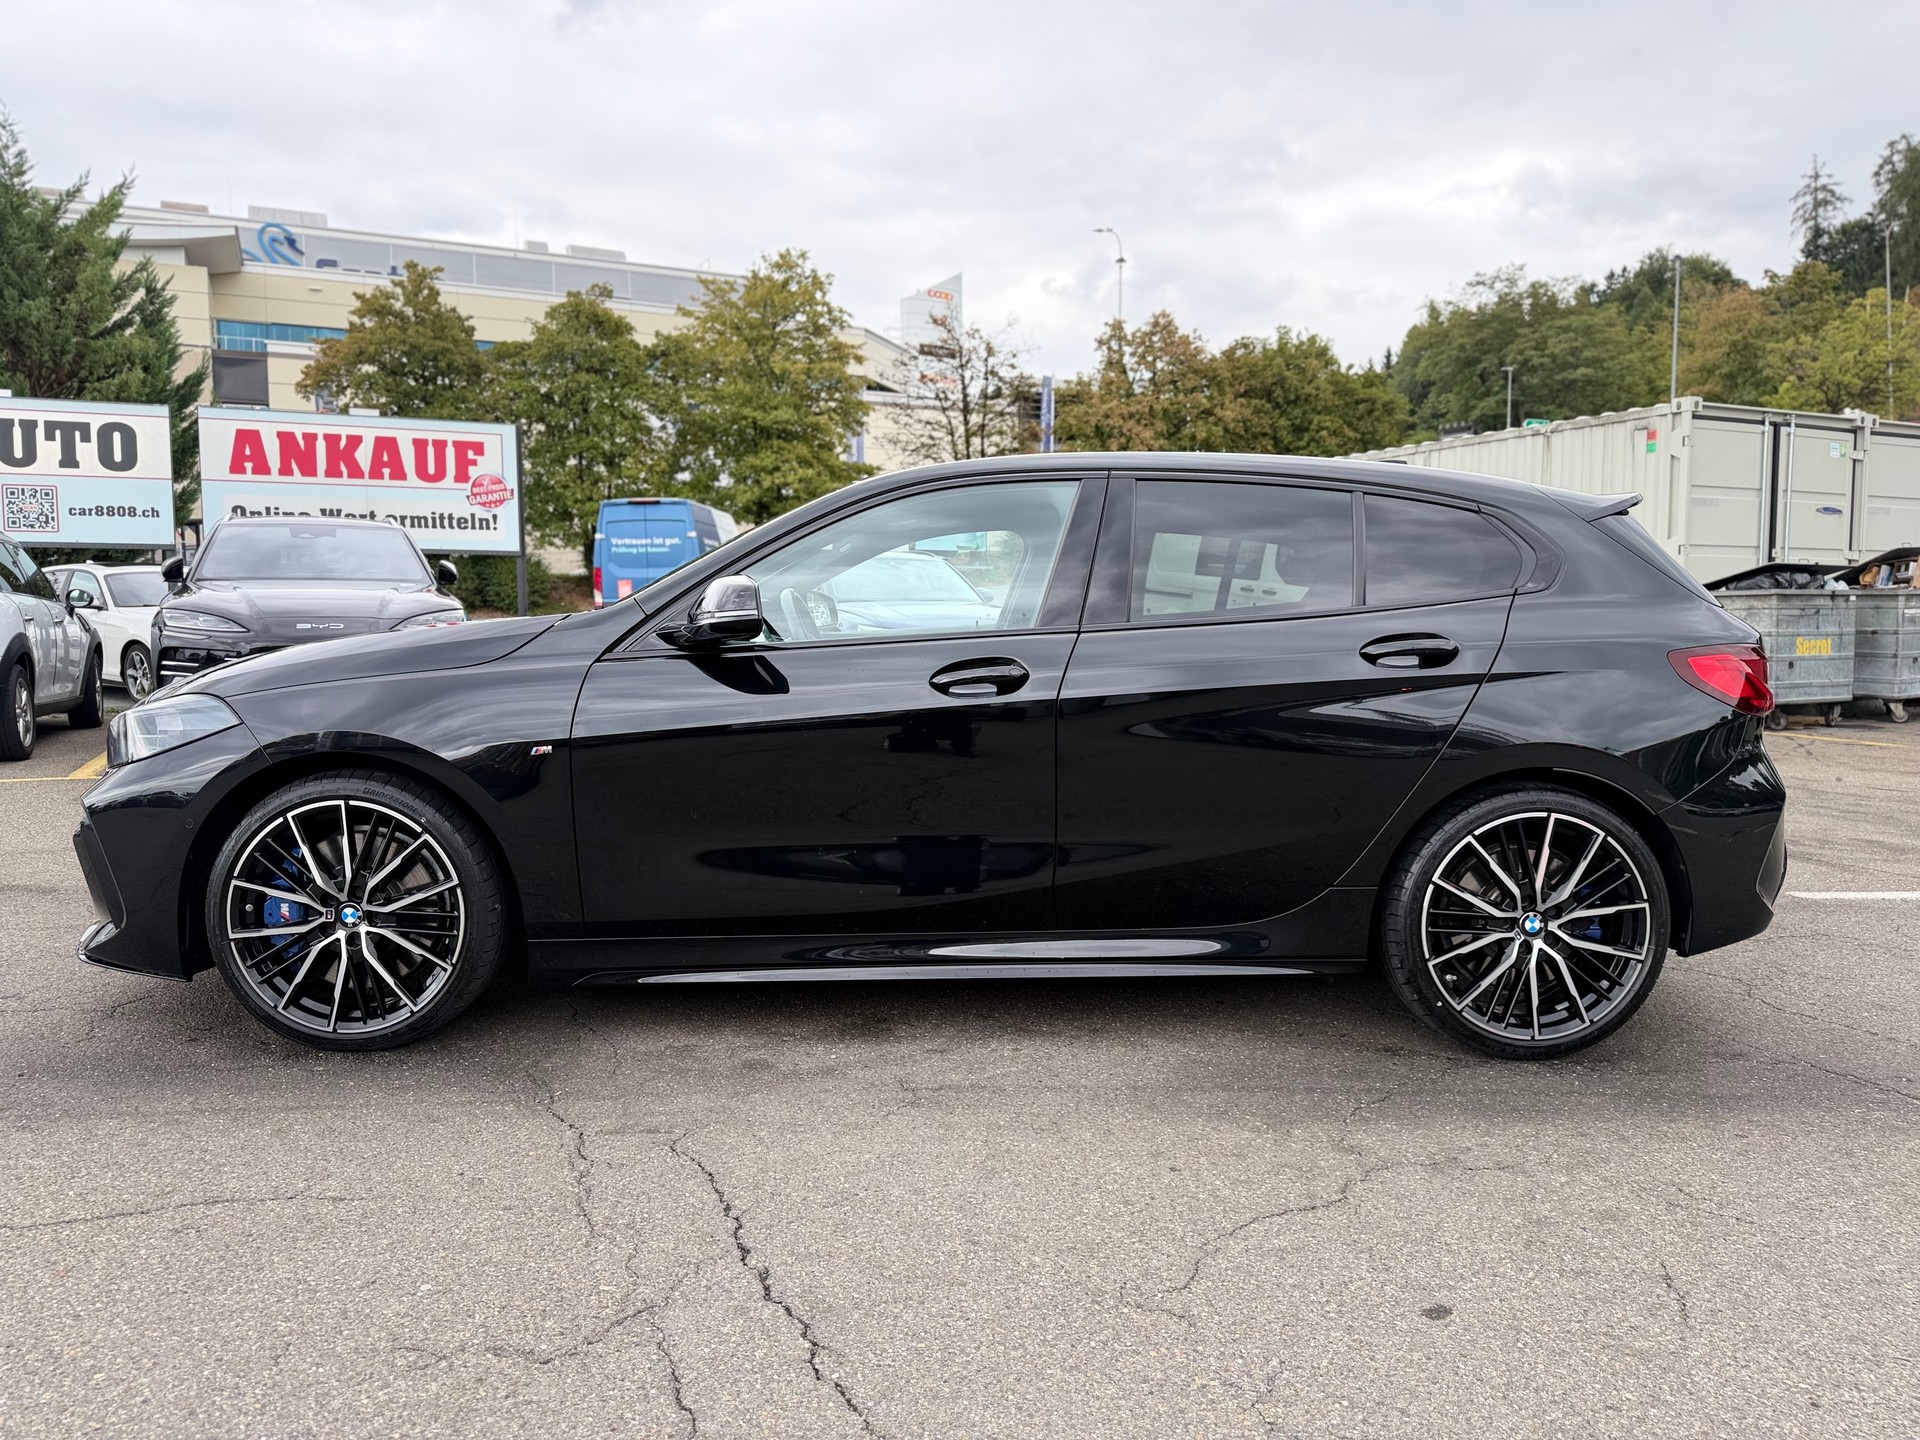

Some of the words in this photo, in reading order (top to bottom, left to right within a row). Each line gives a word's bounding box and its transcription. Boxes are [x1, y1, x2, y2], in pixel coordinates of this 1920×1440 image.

[0, 418, 138, 472] UTO
[229, 428, 485, 484] ANKAUF
[68, 505, 160, 518] car8808.ch
[469, 490, 513, 505] GARANTIE
